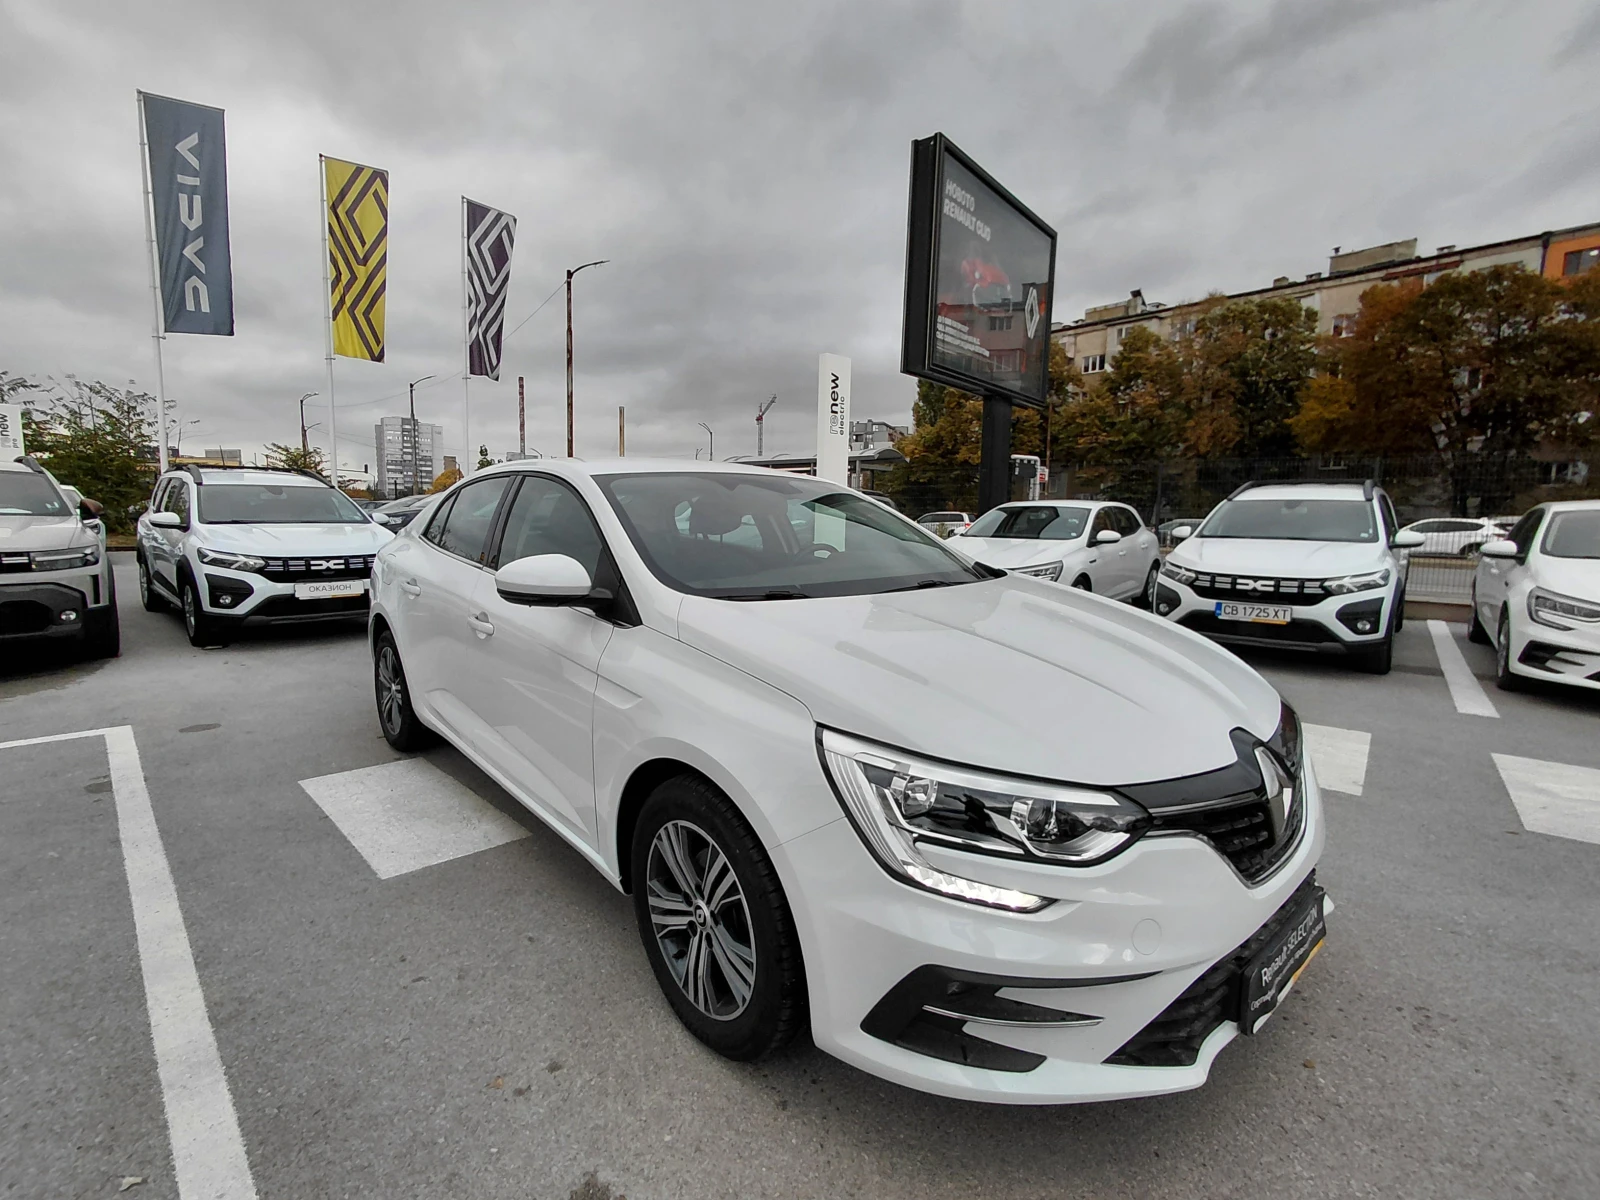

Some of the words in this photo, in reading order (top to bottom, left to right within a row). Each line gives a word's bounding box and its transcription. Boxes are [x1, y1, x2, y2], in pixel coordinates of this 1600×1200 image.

[943, 199, 976, 232] RENAULT
[976, 220, 991, 242] CLIO
[308, 584, 352, 593] ОКАЗИОН
[1242, 606, 1270, 618] 1725
[1261, 945, 1288, 987] Renault
[1287, 904, 1318, 955] SELECTION
